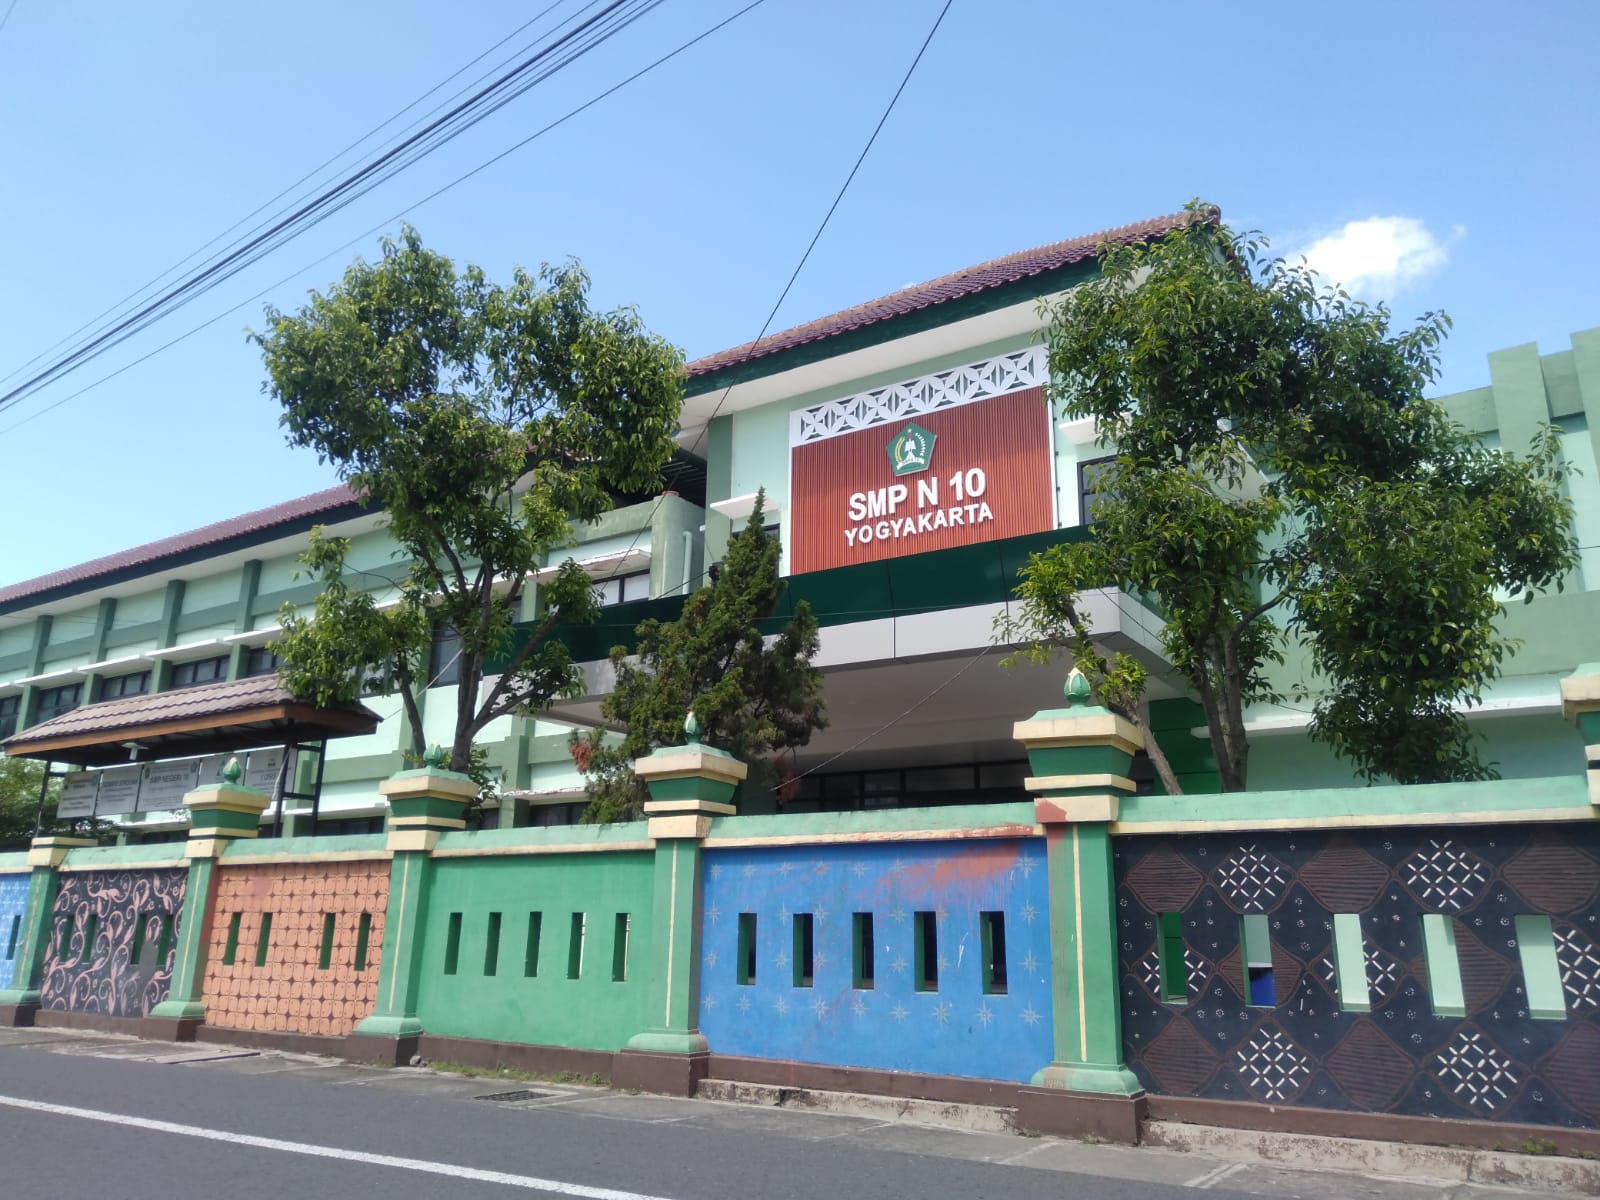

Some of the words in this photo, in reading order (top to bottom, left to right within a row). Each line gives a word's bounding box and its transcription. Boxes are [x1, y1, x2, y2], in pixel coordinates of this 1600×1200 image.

[848, 483, 908, 521] SMP
[917, 476, 939, 508] N
[949, 467, 986, 501] 10
[844, 501, 993, 547] YOGYAKARTA
